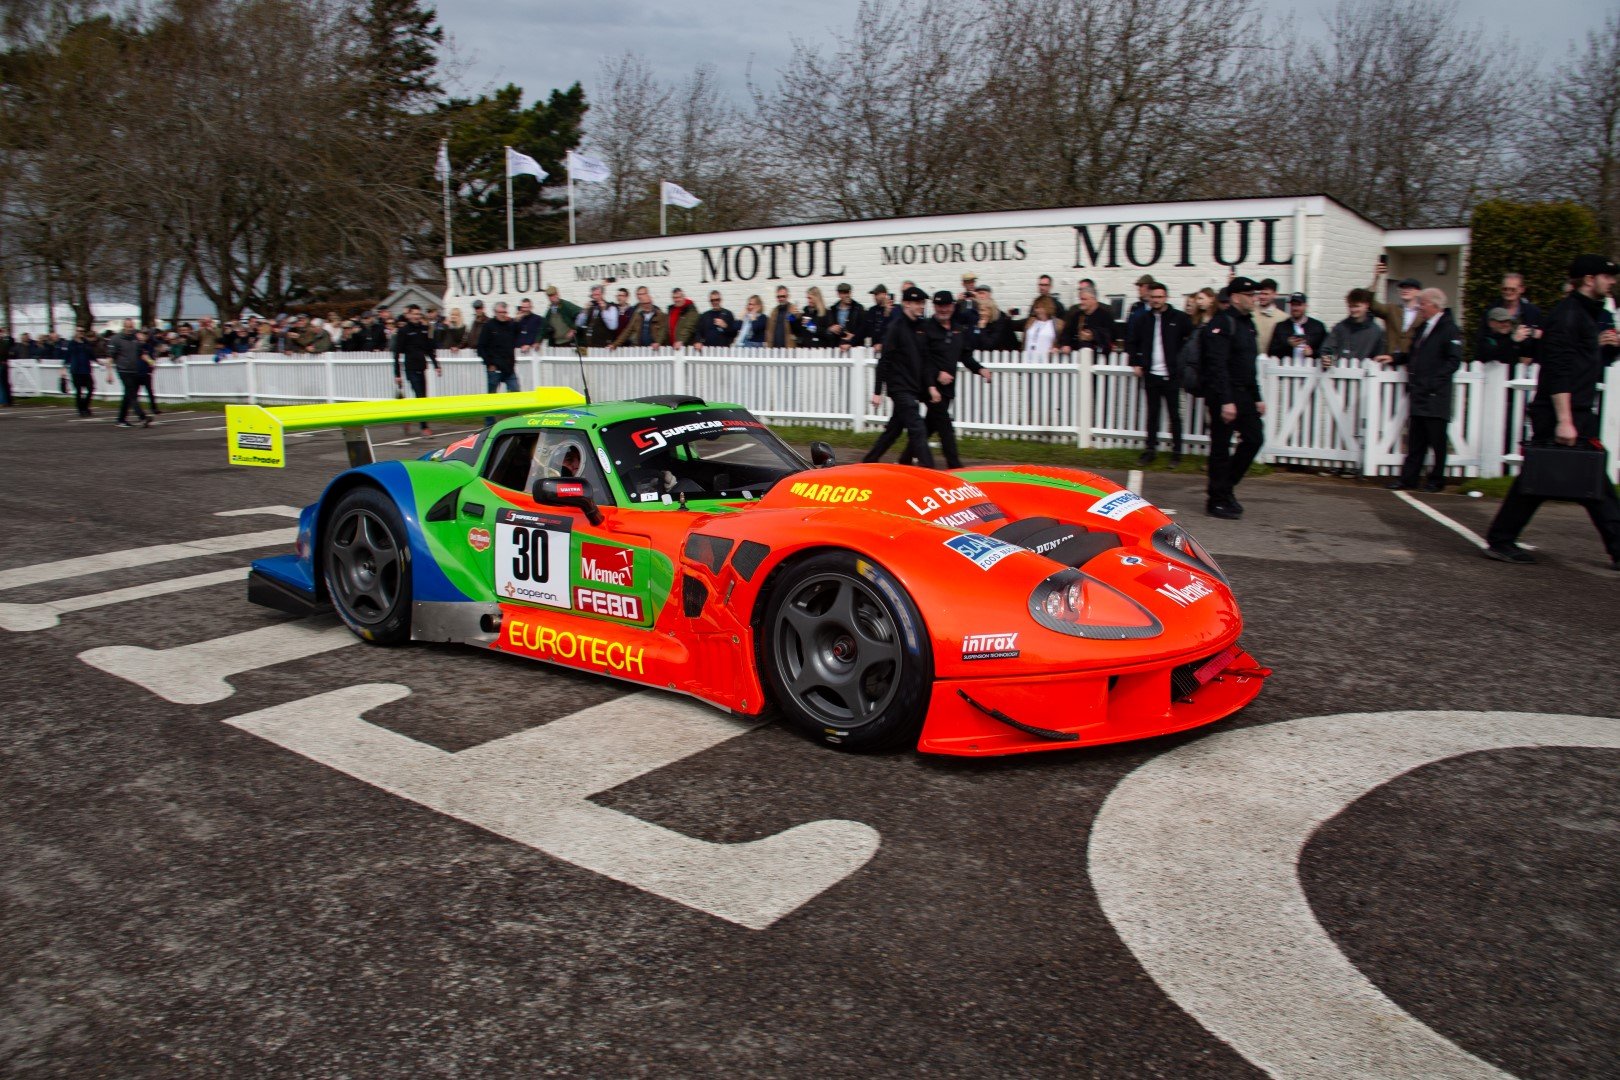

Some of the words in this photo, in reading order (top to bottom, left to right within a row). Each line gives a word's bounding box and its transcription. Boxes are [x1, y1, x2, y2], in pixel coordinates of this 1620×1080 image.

[881, 242, 965, 266] MOTOR
[971, 239, 1028, 262] OILS
[1073, 218, 1295, 269] MOTUL
[574, 261, 630, 283] MOTOR
[634, 259, 671, 280] OILS
[700, 239, 847, 284] MOTUL
[452, 261, 547, 298] MOTUL
[660, 420, 725, 439] SUPERCAR
[790, 482, 873, 503] MARCOS
[906, 495, 942, 516] La
[512, 526, 549, 584] 30
[980, 553, 1002, 569] FOOD
[581, 557, 626, 586] Memec
[577, 588, 639, 620] FEBO
[509, 620, 645, 675] EUROTECH
[990, 651, 1018, 659] TECHNOLOGY
